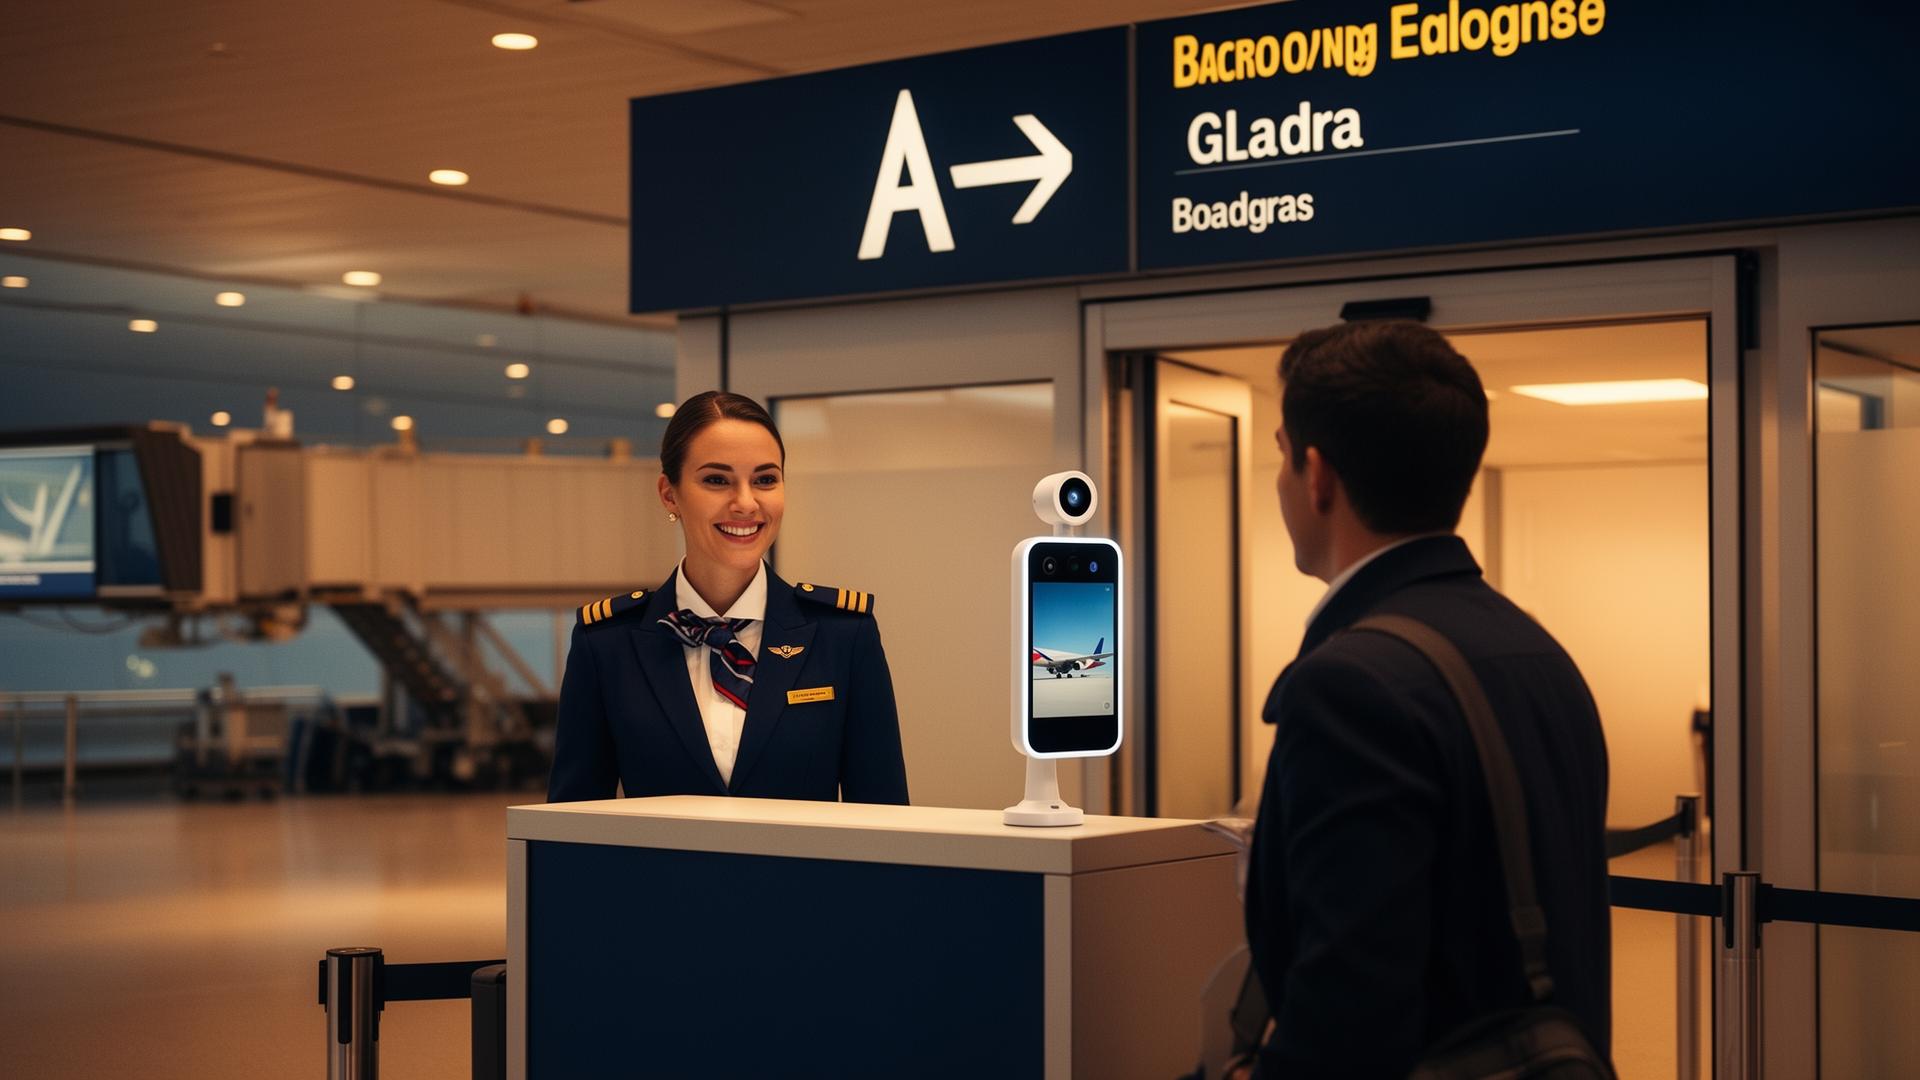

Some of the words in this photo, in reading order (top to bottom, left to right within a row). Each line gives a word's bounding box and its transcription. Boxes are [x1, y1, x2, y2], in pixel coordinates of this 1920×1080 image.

[1187, 101, 1364, 164] GLadra
[857, 89, 955, 260] A
[1172, 190, 1315, 234] Boadgras
